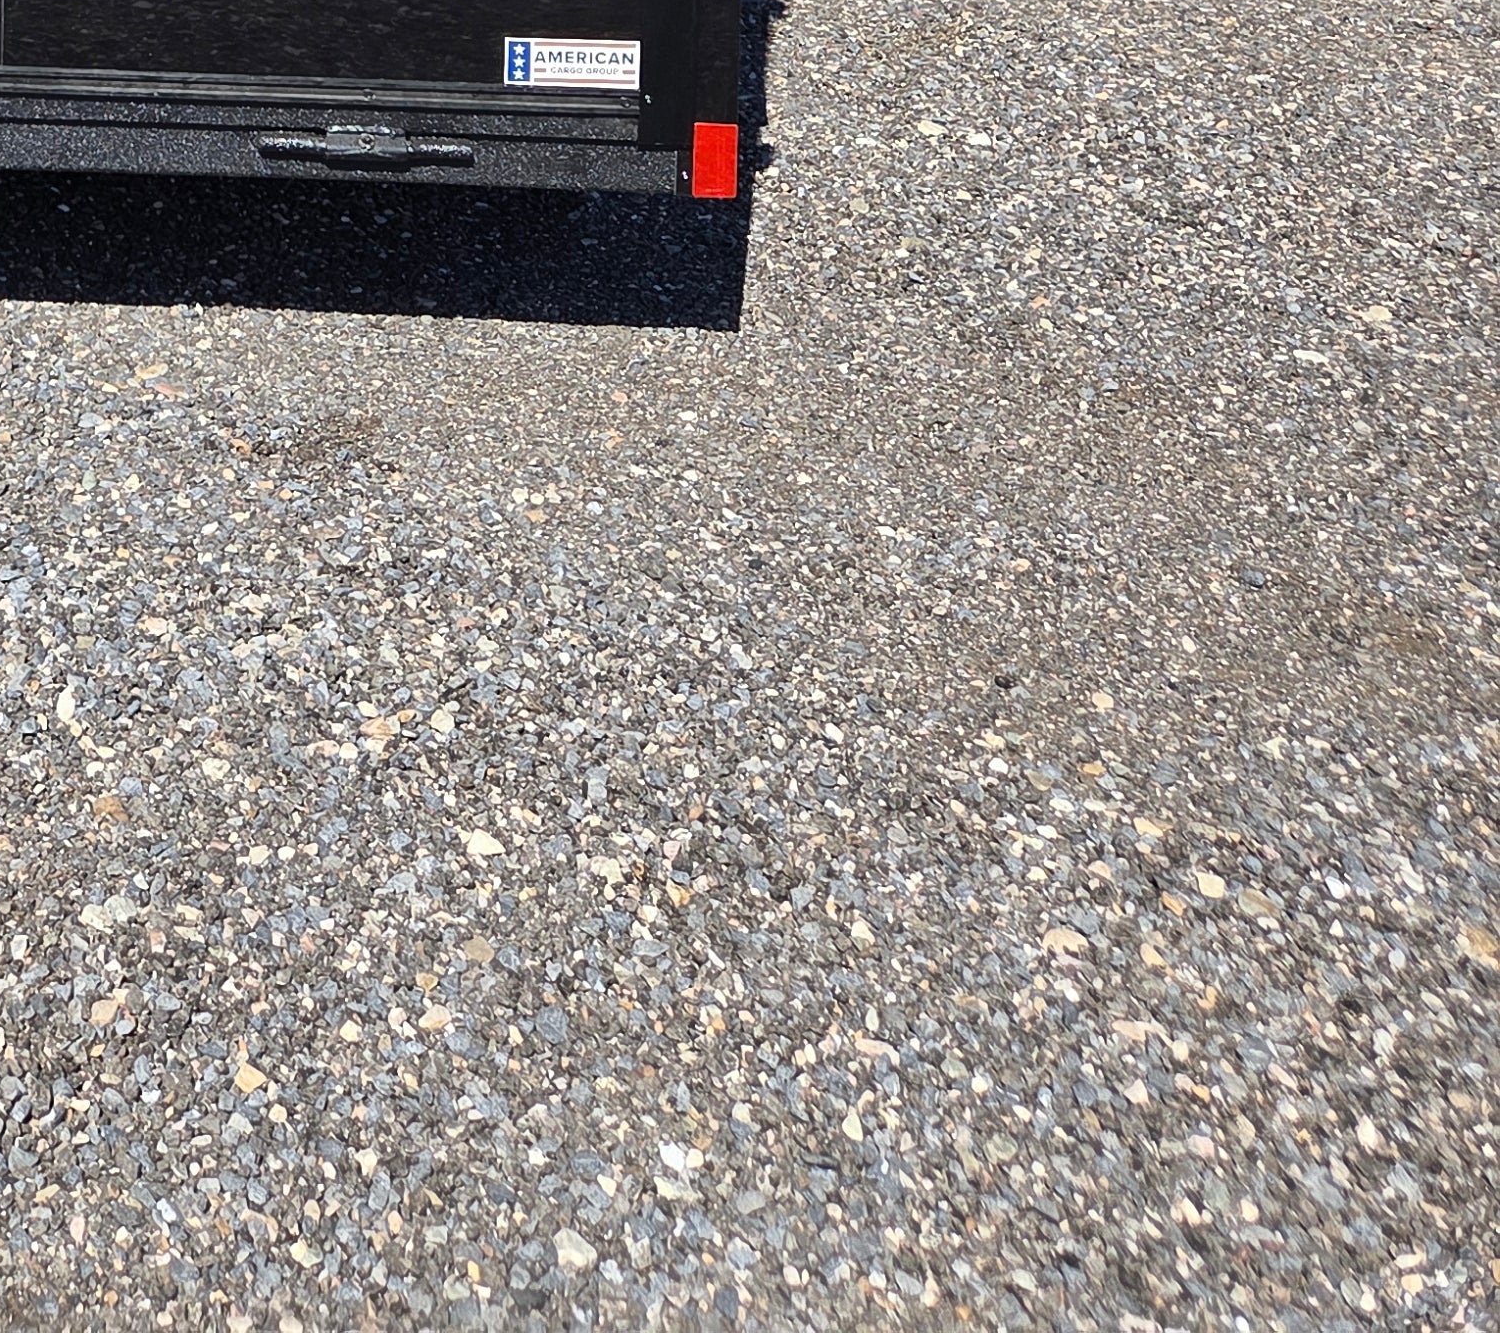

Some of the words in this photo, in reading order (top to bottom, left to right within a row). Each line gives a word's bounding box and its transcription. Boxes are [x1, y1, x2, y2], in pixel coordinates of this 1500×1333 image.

[534, 51, 634, 65] AMERICAN
[550, 66, 583, 74] CARGO
[586, 67, 620, 75] GROUP
